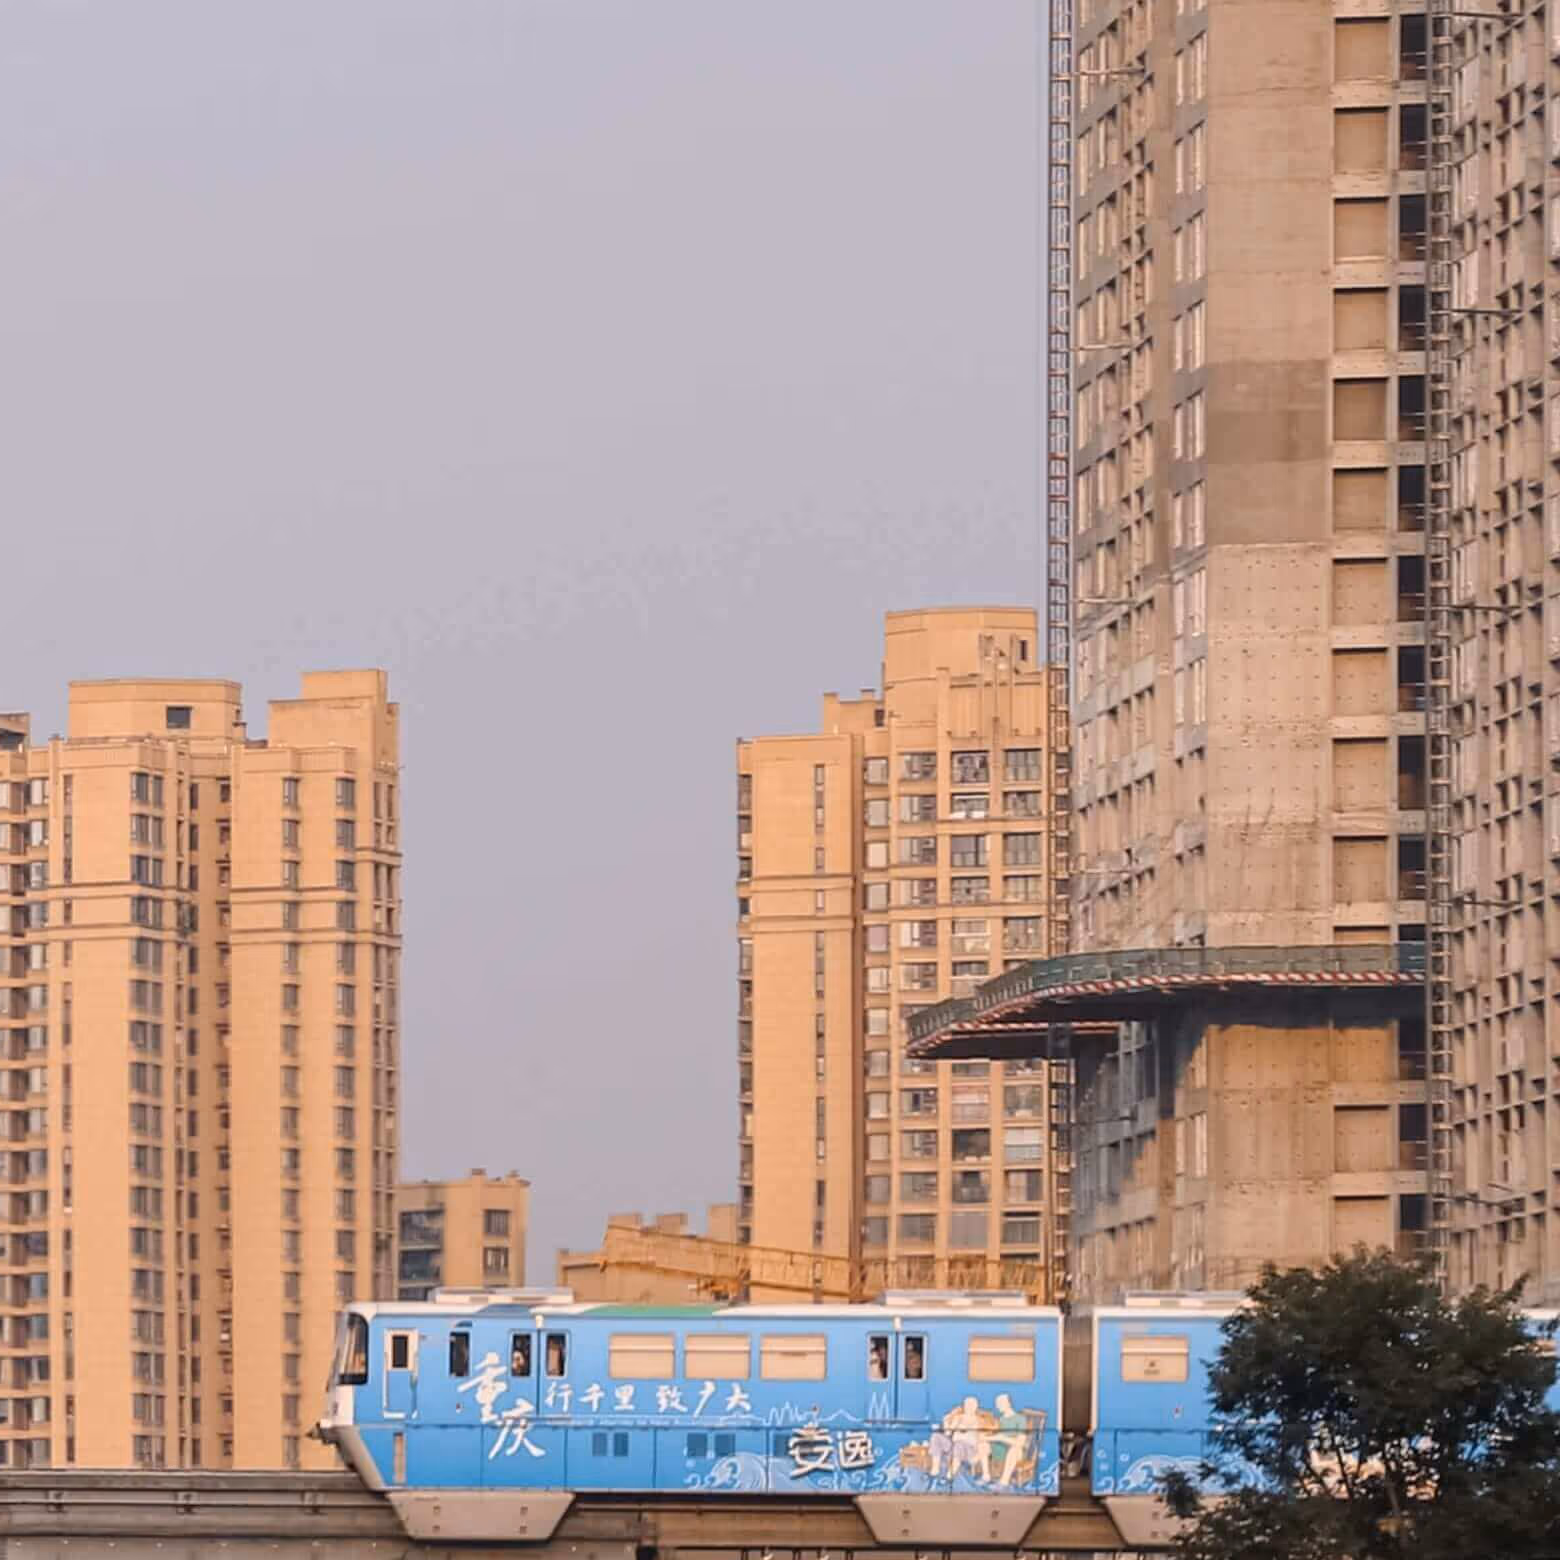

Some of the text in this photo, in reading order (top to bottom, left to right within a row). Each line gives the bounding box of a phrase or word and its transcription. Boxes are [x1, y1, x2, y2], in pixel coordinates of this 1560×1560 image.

[458, 1352, 545, 1460] 重庆
[545, 1380, 636, 1413] 行千里
[788, 1421, 876, 1478] 安逸
